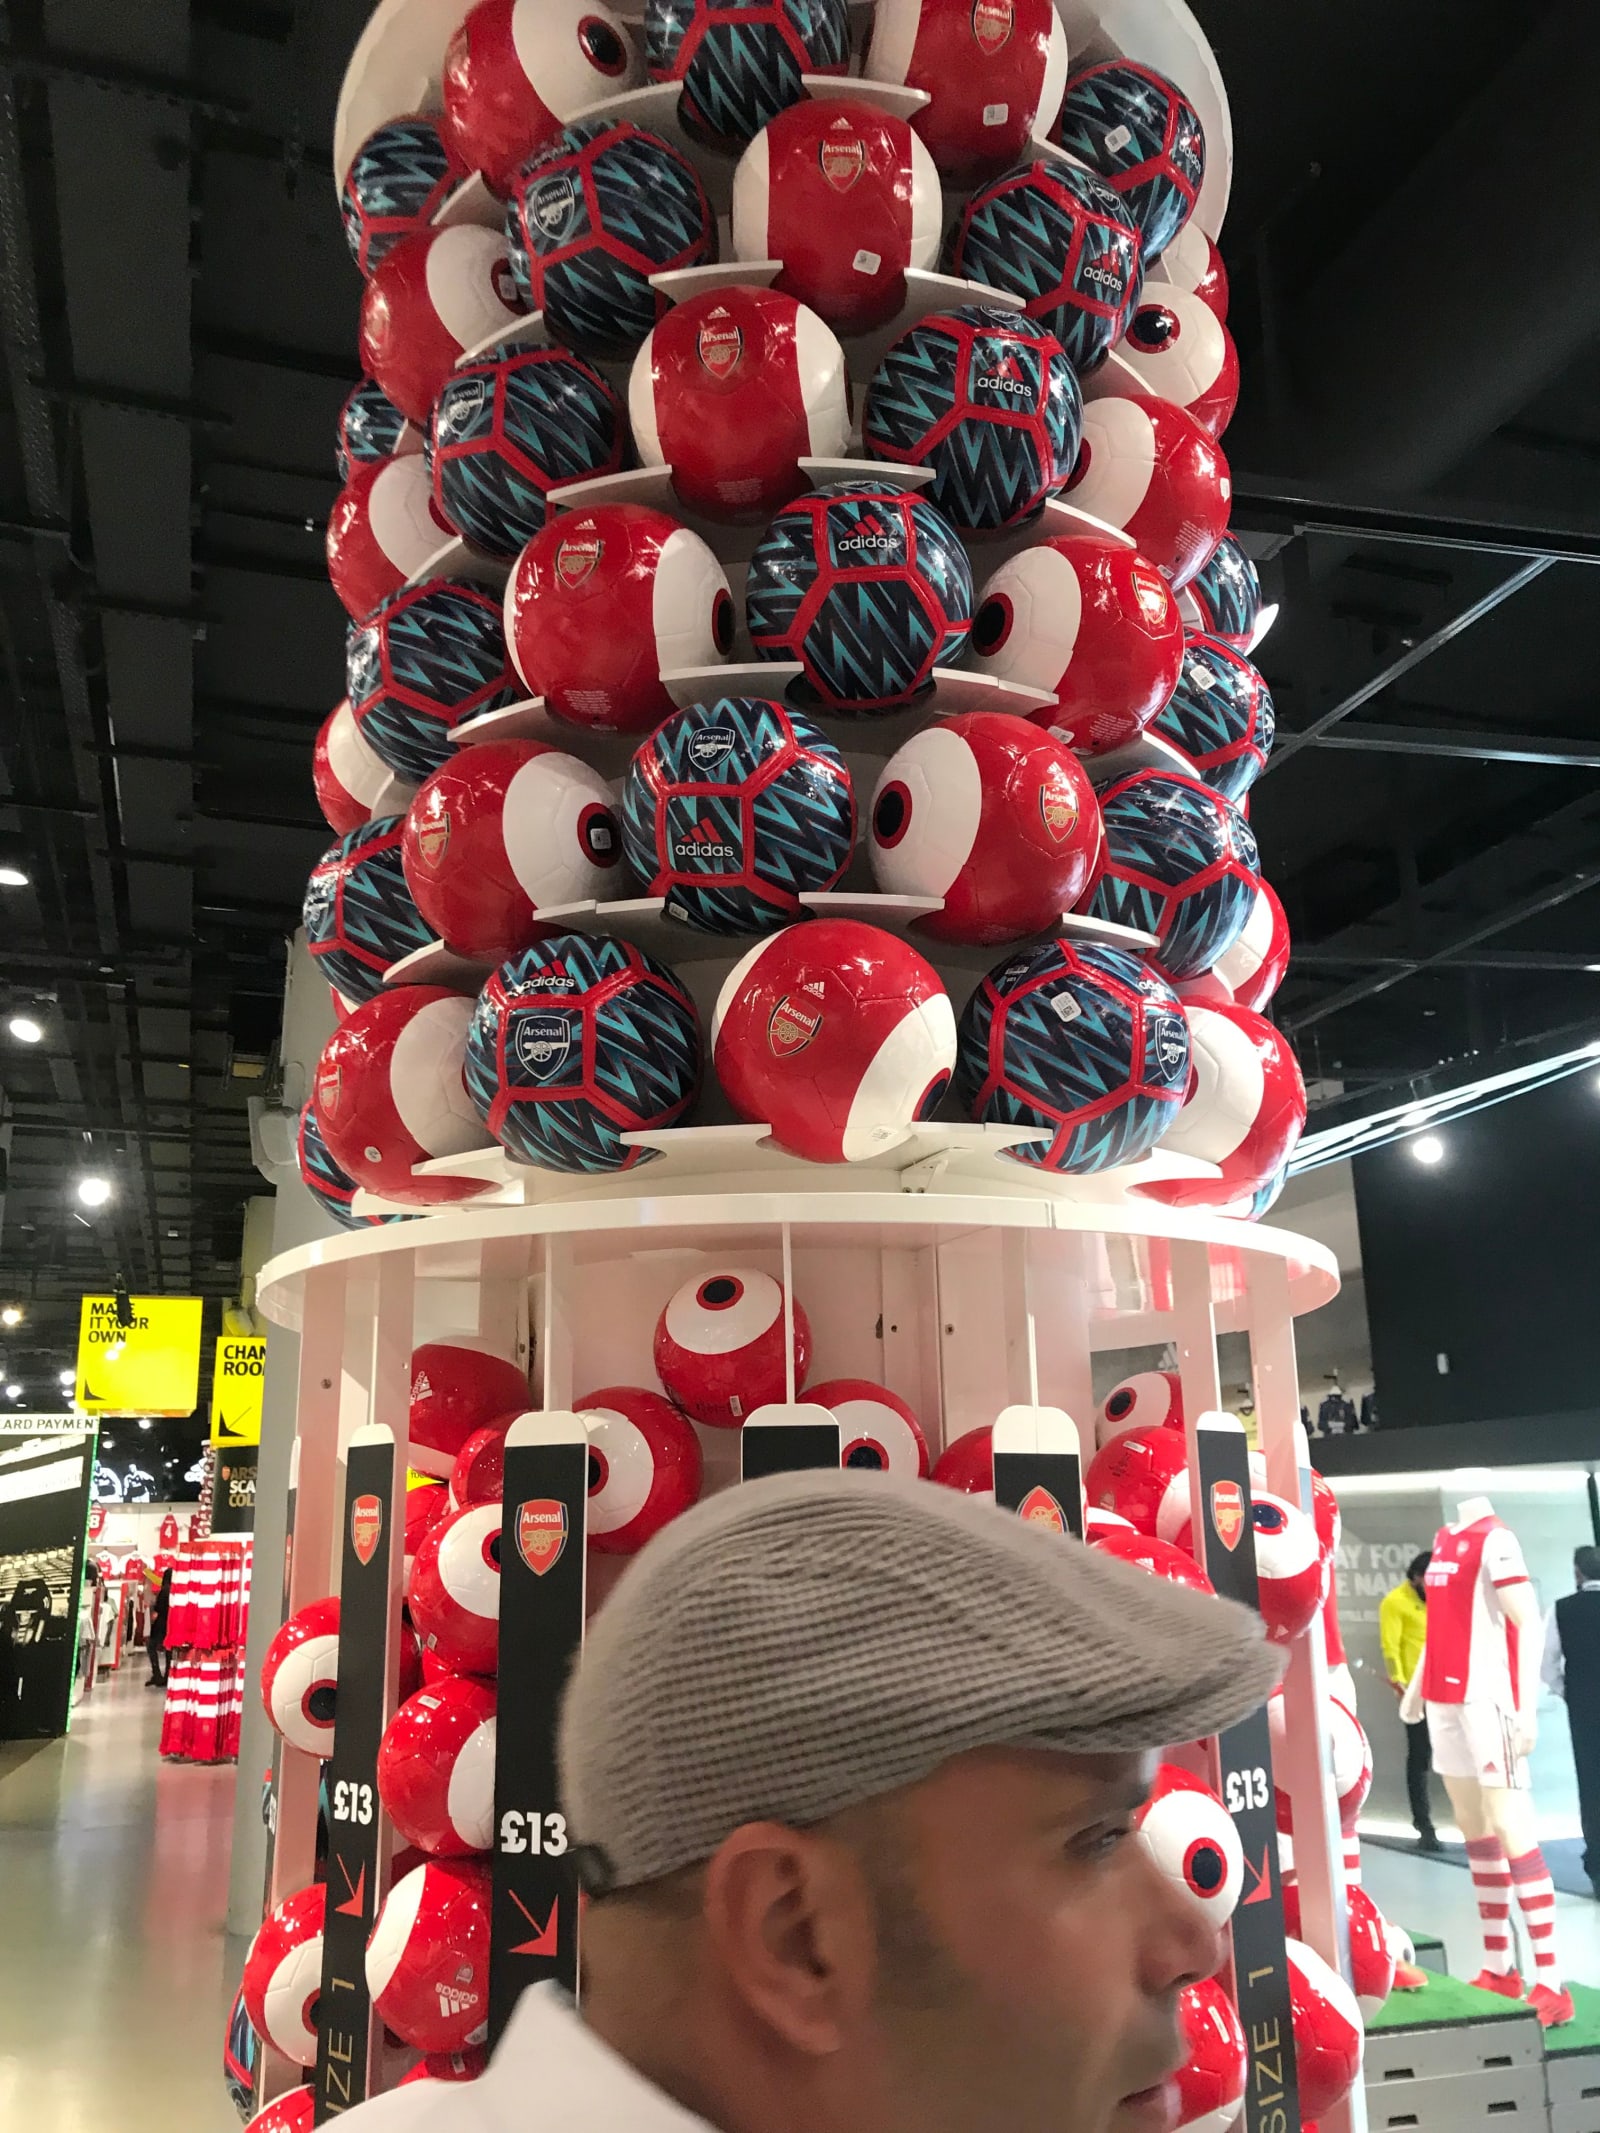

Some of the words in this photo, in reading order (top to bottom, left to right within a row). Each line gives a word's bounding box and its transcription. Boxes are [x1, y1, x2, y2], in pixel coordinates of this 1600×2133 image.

[825, 144, 861, 154] Arsenal
[1083, 265, 1123, 292] adidas
[701, 330, 738, 344] Arsenal
[977, 375, 1033, 397] adidas
[838, 535, 900, 551] adidas
[696, 733, 730, 742] Arsenal
[675, 843, 734, 857] adidas
[521, 976, 575, 989] adidas
[780, 1001, 816, 1027] Arsenal
[523, 1026, 563, 1037] Arsenal
[90, 1316, 104, 1329] IT
[88, 1330, 126, 1343] OWN
[223, 1361, 265, 1376] ROO
[0, 1419, 33, 1430] ARD
[522, 1511, 561, 1525] Arsenal
[164, 1524, 173, 1538] 4
[1225, 1767, 1269, 1813] £13
[333, 1780, 373, 1826] £13
[500, 1810, 568, 1857] £13
[1249, 1966, 1274, 1988] 1
[435, 1981, 478, 2005] adidas
